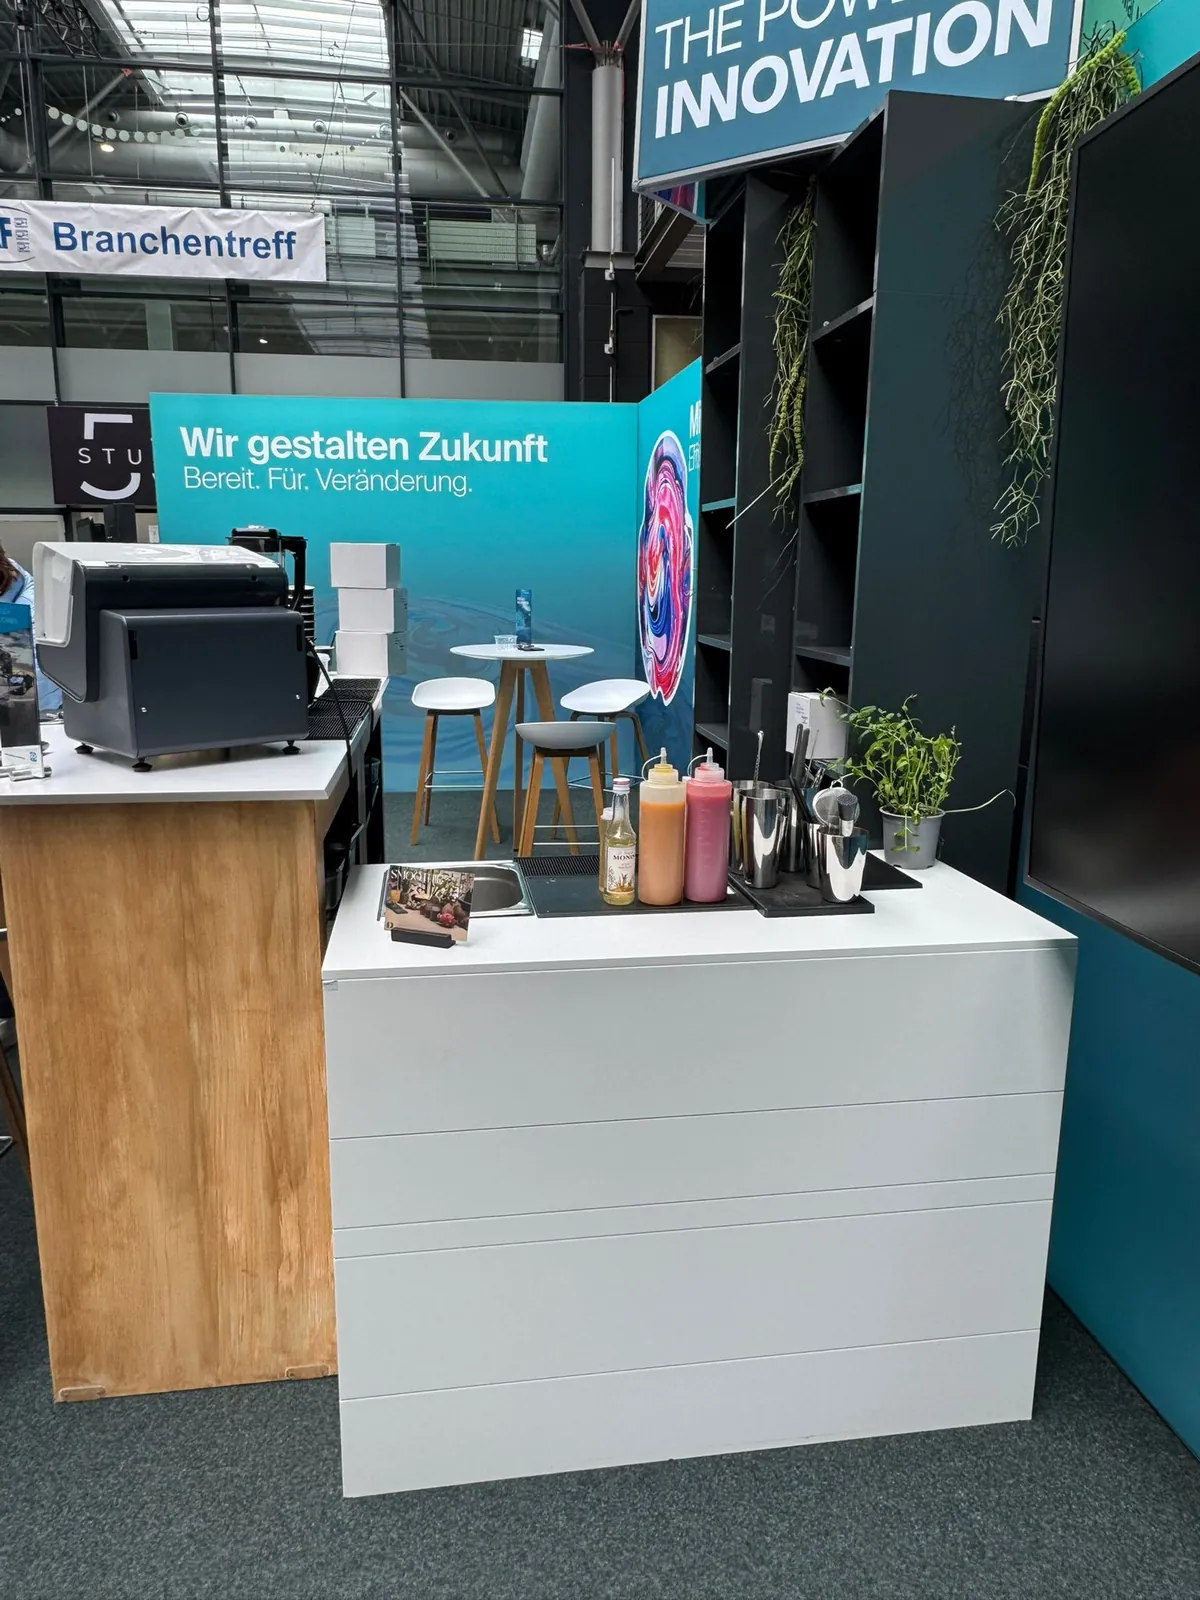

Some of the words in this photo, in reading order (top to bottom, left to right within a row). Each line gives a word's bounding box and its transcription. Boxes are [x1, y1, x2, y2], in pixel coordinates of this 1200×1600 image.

[655, 0, 743, 70] THE
[655, 0, 1052, 139] INNOVATION
[53, 221, 297, 260] Branchentreff
[179, 426, 239, 459] Wir
[247, 429, 409, 465] gestalten
[418, 431, 548, 463] Zukunft
[183, 465, 260, 490] Bereit.
[268, 466, 309, 491] Für.
[319, 468, 473, 498] Veränderung.
